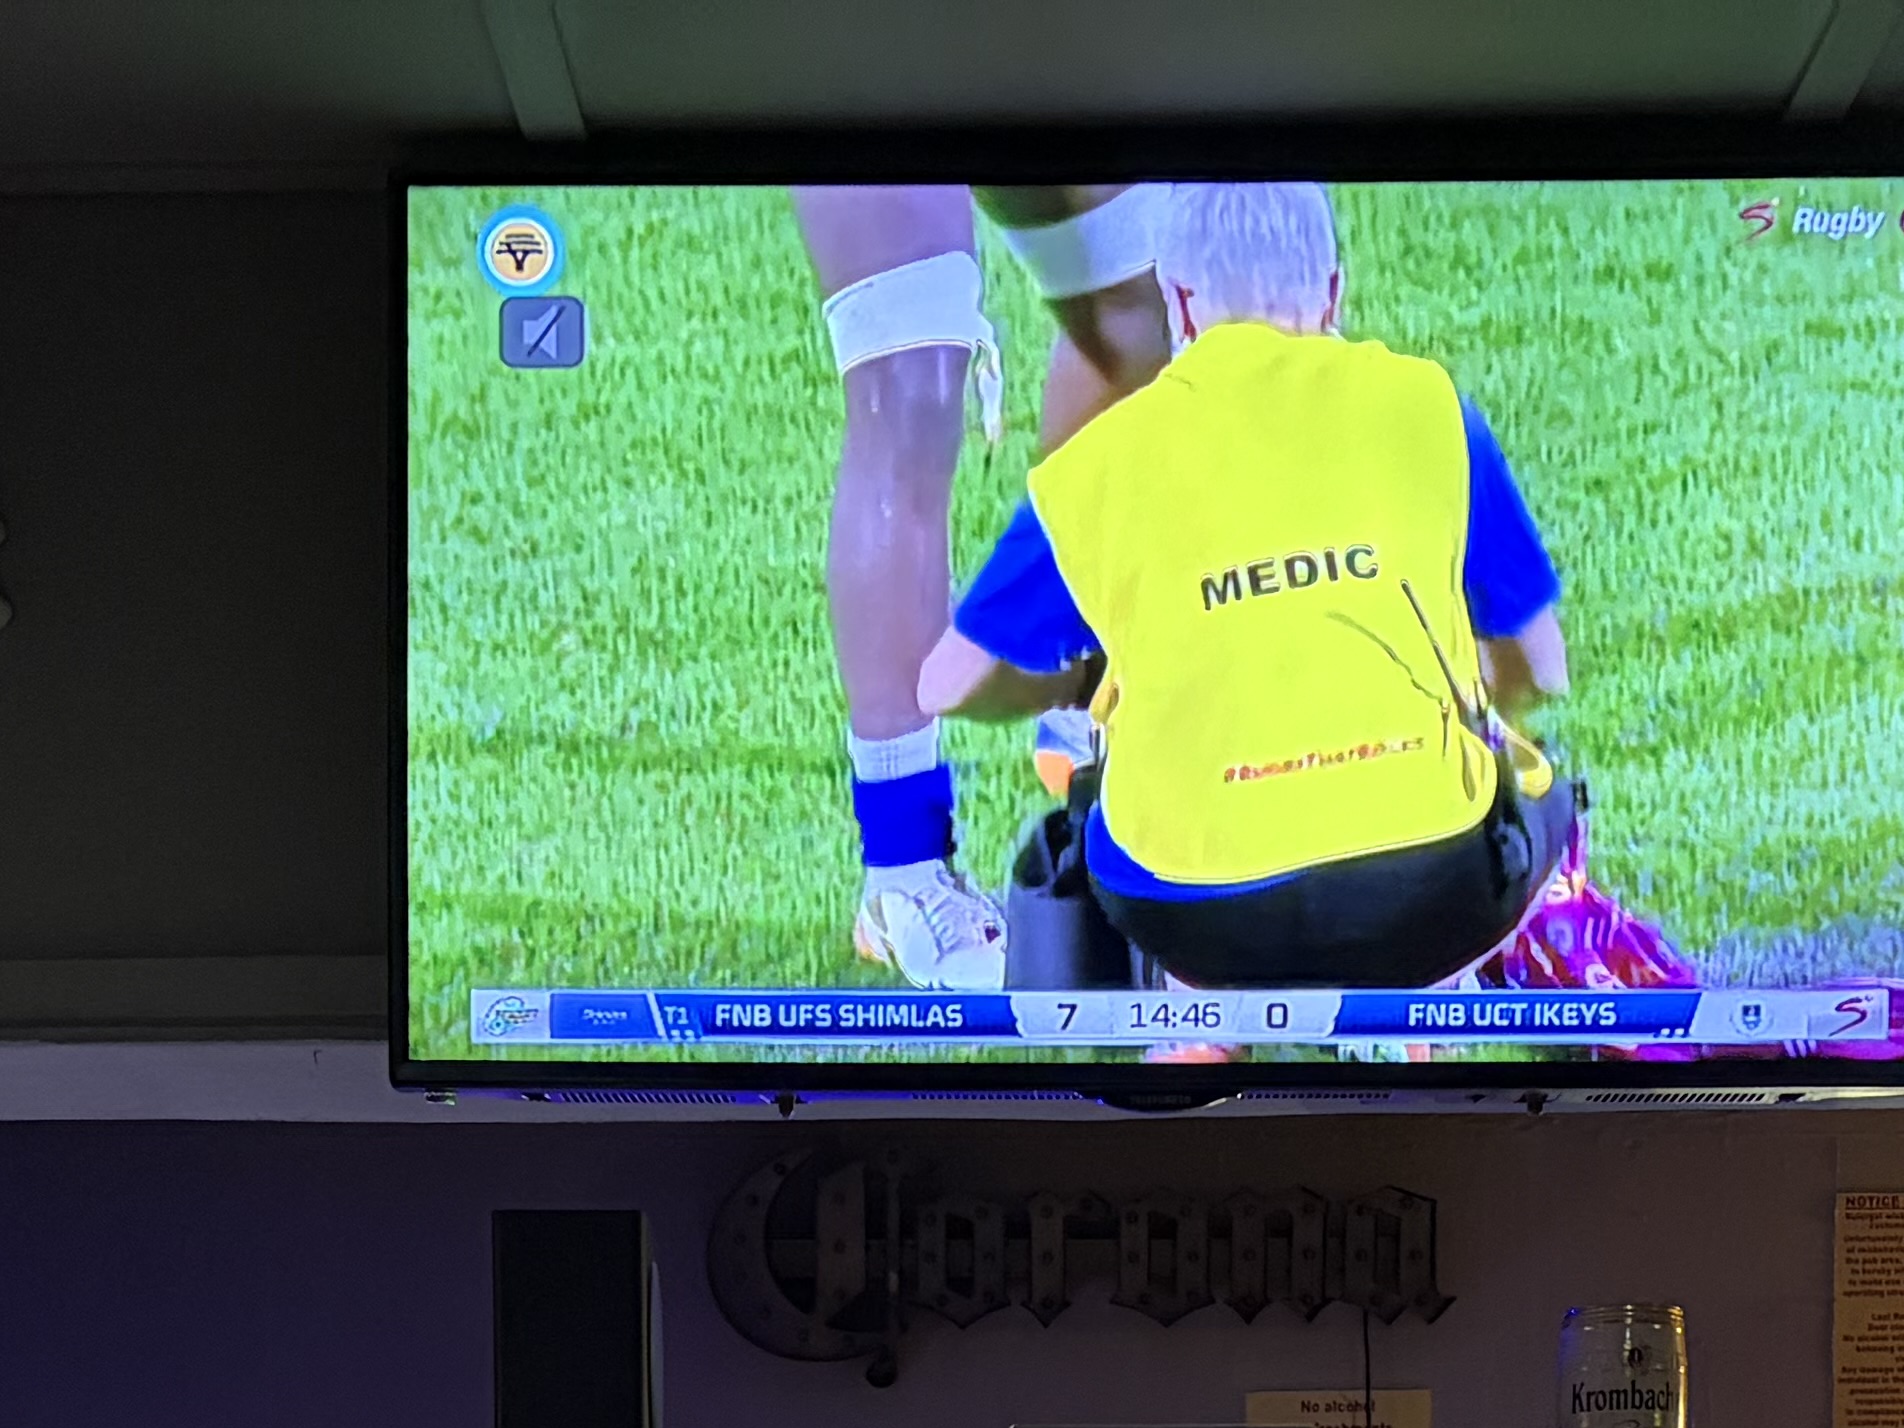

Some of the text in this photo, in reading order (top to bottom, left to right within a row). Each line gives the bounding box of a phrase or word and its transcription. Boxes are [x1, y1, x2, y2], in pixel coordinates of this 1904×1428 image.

[1792, 205, 1885, 240] Rugby
[1199, 543, 1379, 612] MEDIC
[714, 1004, 771, 1028] FNB
[778, 1004, 833, 1028] UFS
[837, 1004, 965, 1028] SHIMLAS
[1057, 1004, 1080, 1030] 7
[1128, 1003, 1222, 1029] 14:46
[1265, 1003, 1289, 1030] 0
[1407, 1002, 1466, 1027] FNB
[1472, 1002, 1531, 1027] UCT
[1534, 1002, 1618, 1027] IKEYS
[1846, 1195, 1900, 1208] NOTICE
[1300, 1400, 1376, 1413] No alcohol
